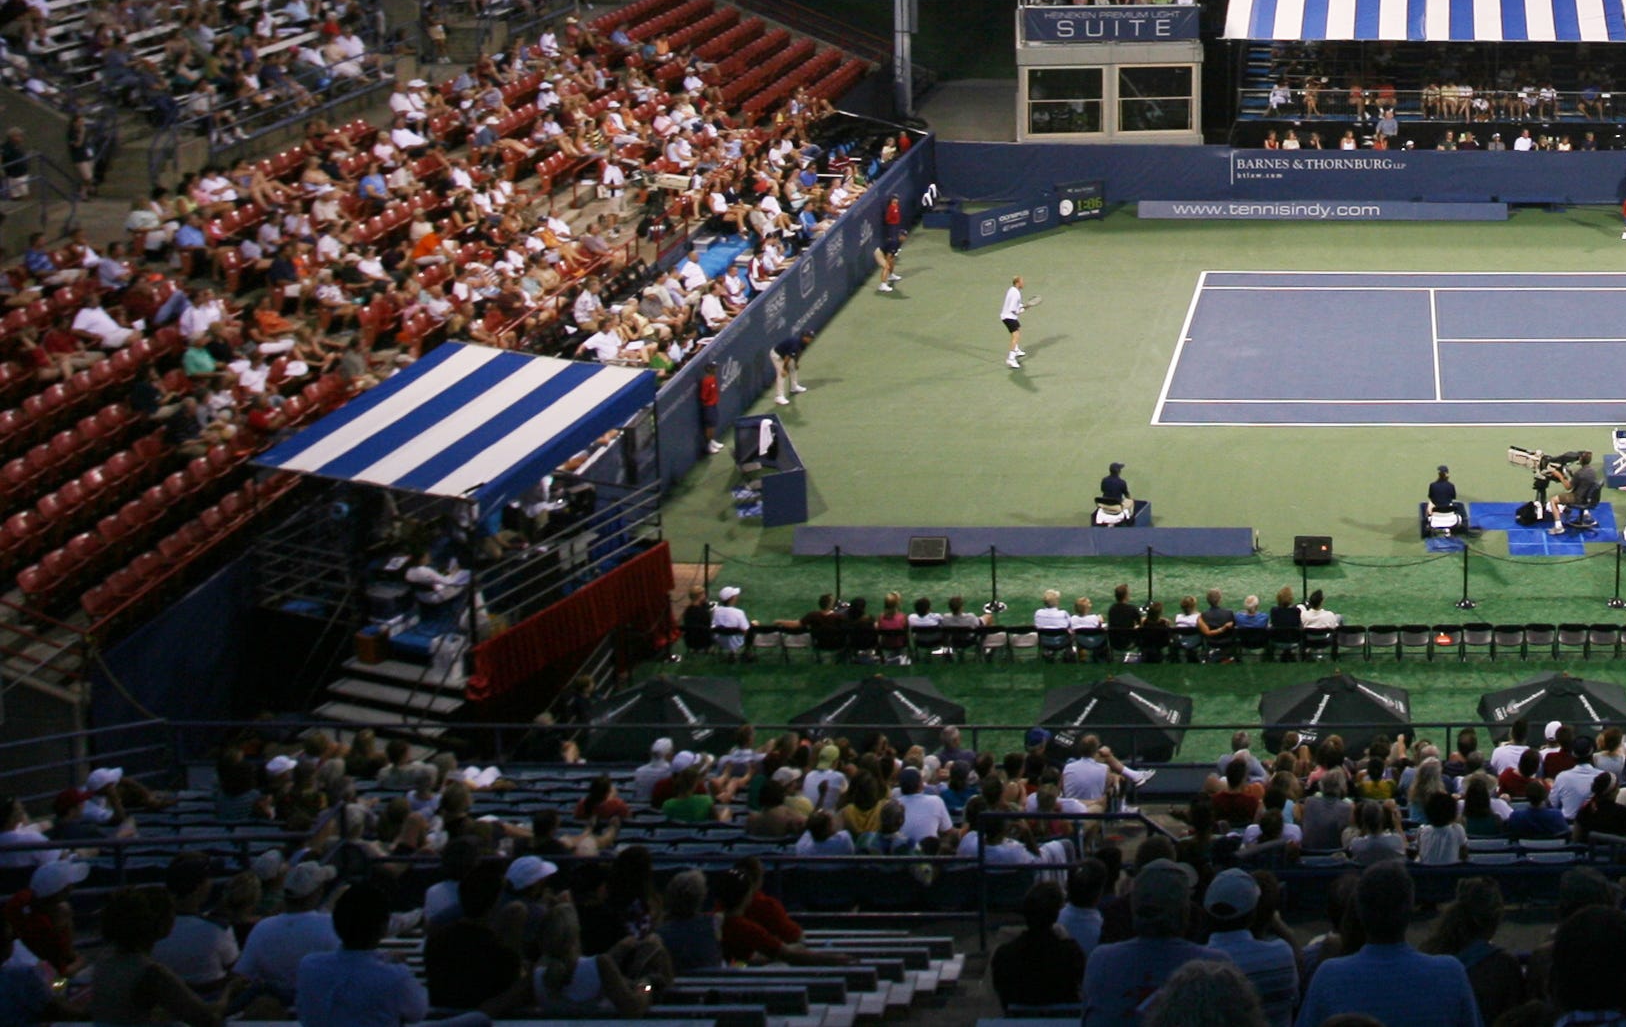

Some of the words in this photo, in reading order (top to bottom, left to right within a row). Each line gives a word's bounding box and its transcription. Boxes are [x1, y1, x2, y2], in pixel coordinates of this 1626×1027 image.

[1044, 11, 1096, 19] HEINEKEN
[1100, 11, 1149, 19] PREMIUM
[1151, 11, 1181, 19] LIGHT
[1056, 20, 1171, 37] SUITE
[1236, 159, 1289, 169] BARNES
[1292, 159, 1303, 170] &
[1305, 158, 1392, 169] THORNBURG
[1172, 203, 1381, 219] www.tennisindy.com
